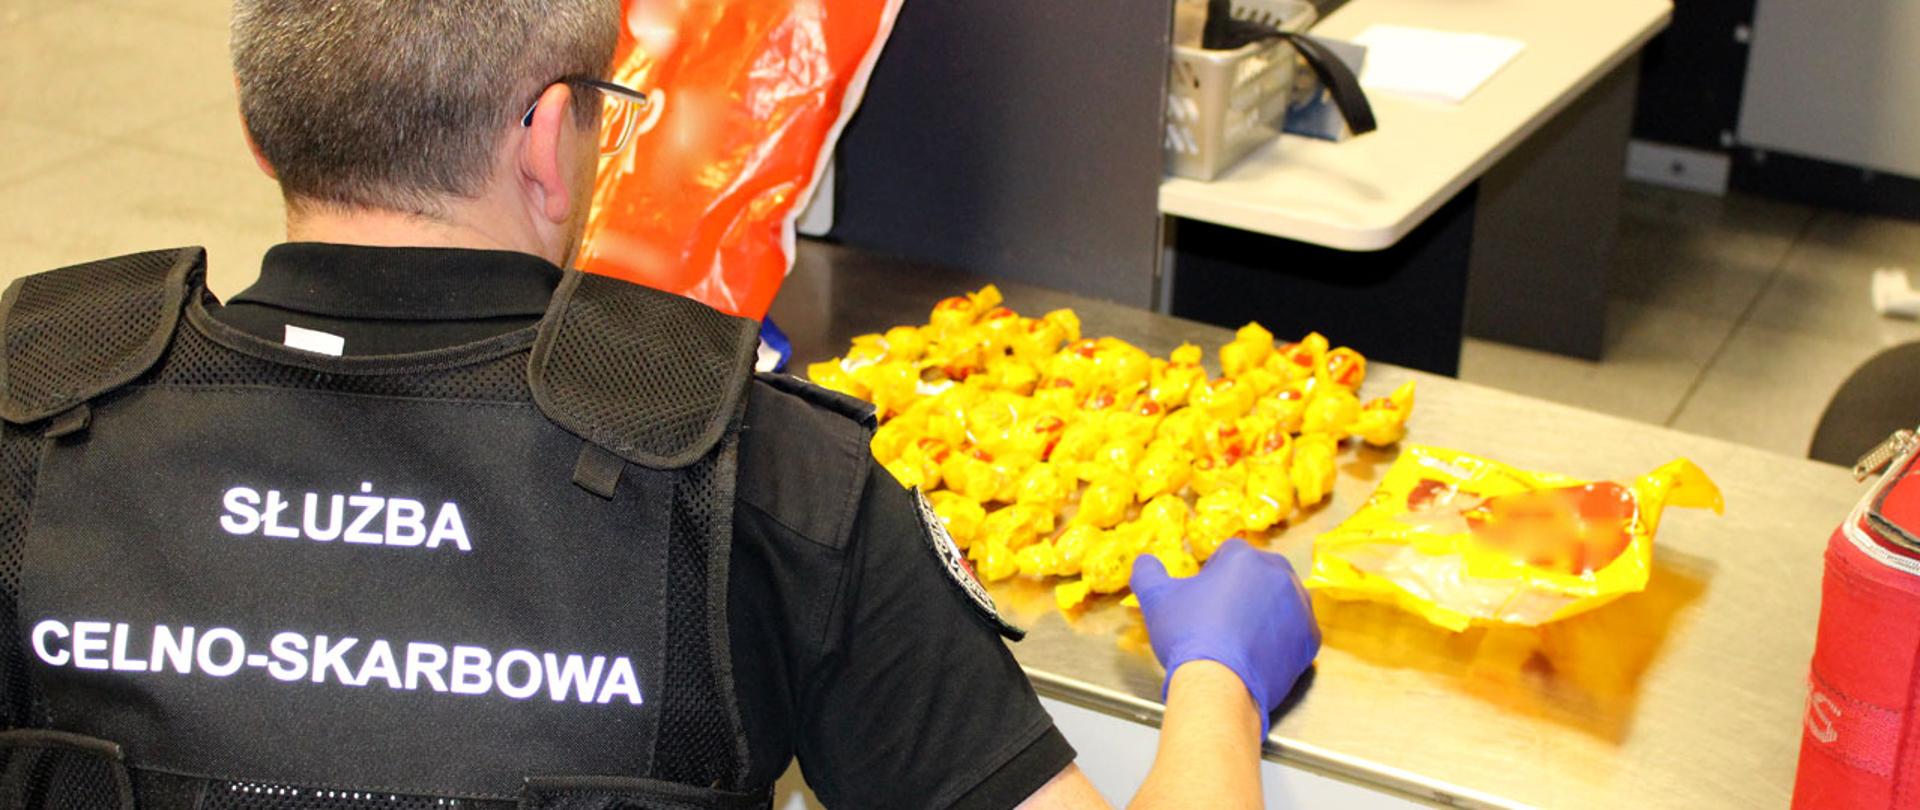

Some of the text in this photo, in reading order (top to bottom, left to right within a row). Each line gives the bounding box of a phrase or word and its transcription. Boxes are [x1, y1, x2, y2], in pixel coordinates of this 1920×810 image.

[219, 482, 472, 550] SŁUŻBA
[31, 620, 643, 705] CELNO-SKARBOWA
[1805, 691, 1842, 743] S
